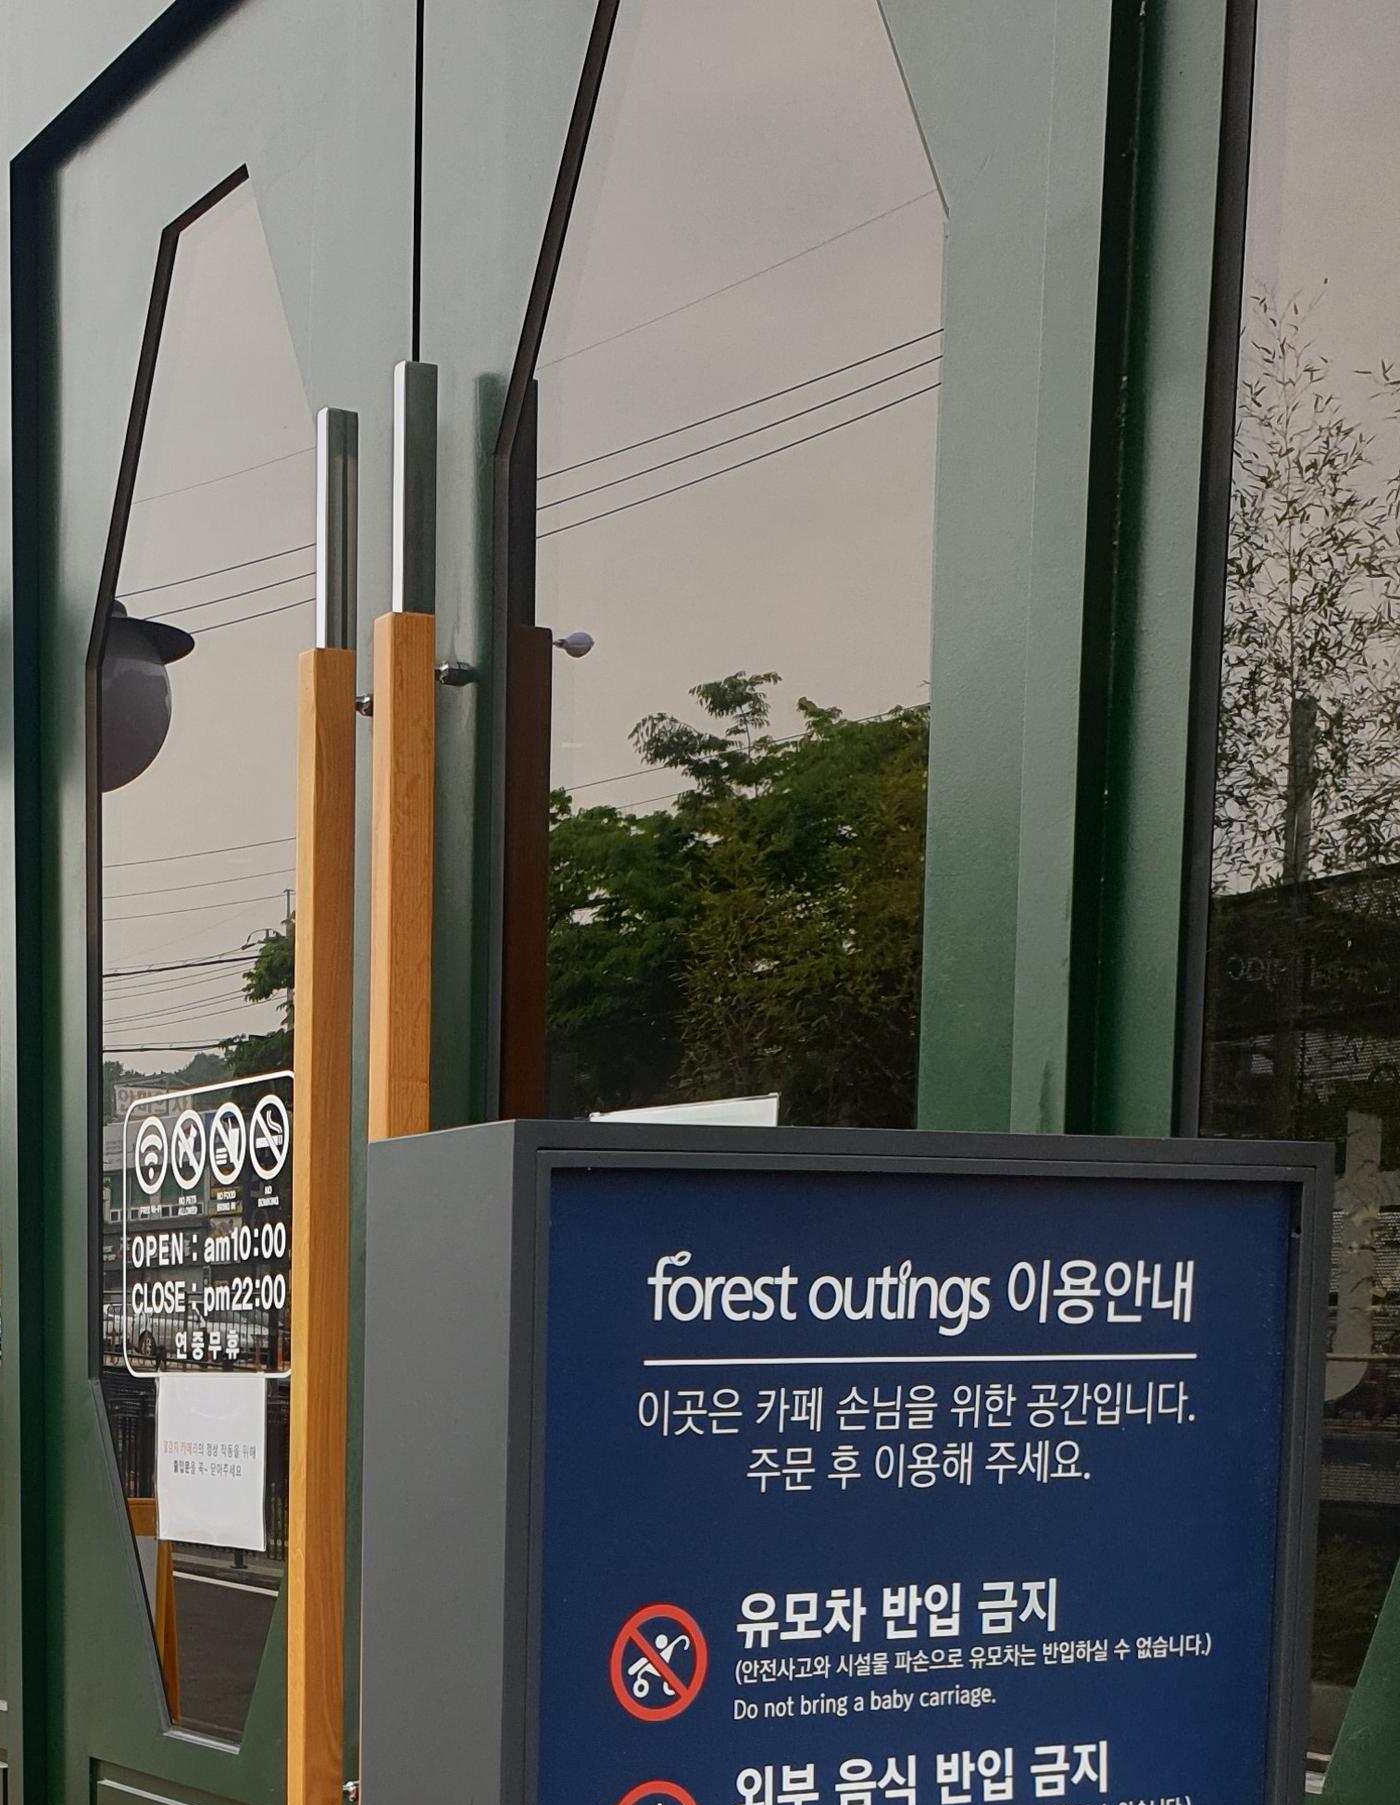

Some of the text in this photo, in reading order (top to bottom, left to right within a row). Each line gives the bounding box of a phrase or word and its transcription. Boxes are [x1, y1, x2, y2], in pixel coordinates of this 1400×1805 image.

[132, 1222, 286, 1268] OPEN am10:00
[132, 1273, 286, 1317] CLOSE pm22:00
[647, 1250, 1195, 1337] forest outings 이용안내
[175, 1328, 240, 1361] 연중무휴
[638, 1381, 1195, 1437] 이곳은 카페 손님을 위한 공간입니다.
[746, 1439, 1091, 1493] 주문 후 이용해 주세요.
[736, 1577, 1057, 1649] 유모차 반입 금지
[735, 1632, 1212, 1686] (안전사고와 시설물 파손으로 유모차는 반입하실 수 없습니다.)
[734, 1684, 996, 1720] Do not bring a baby carriage.
[936, 1747, 1014, 1805] 반입
[1030, 1740, 1108, 1798] 금지
